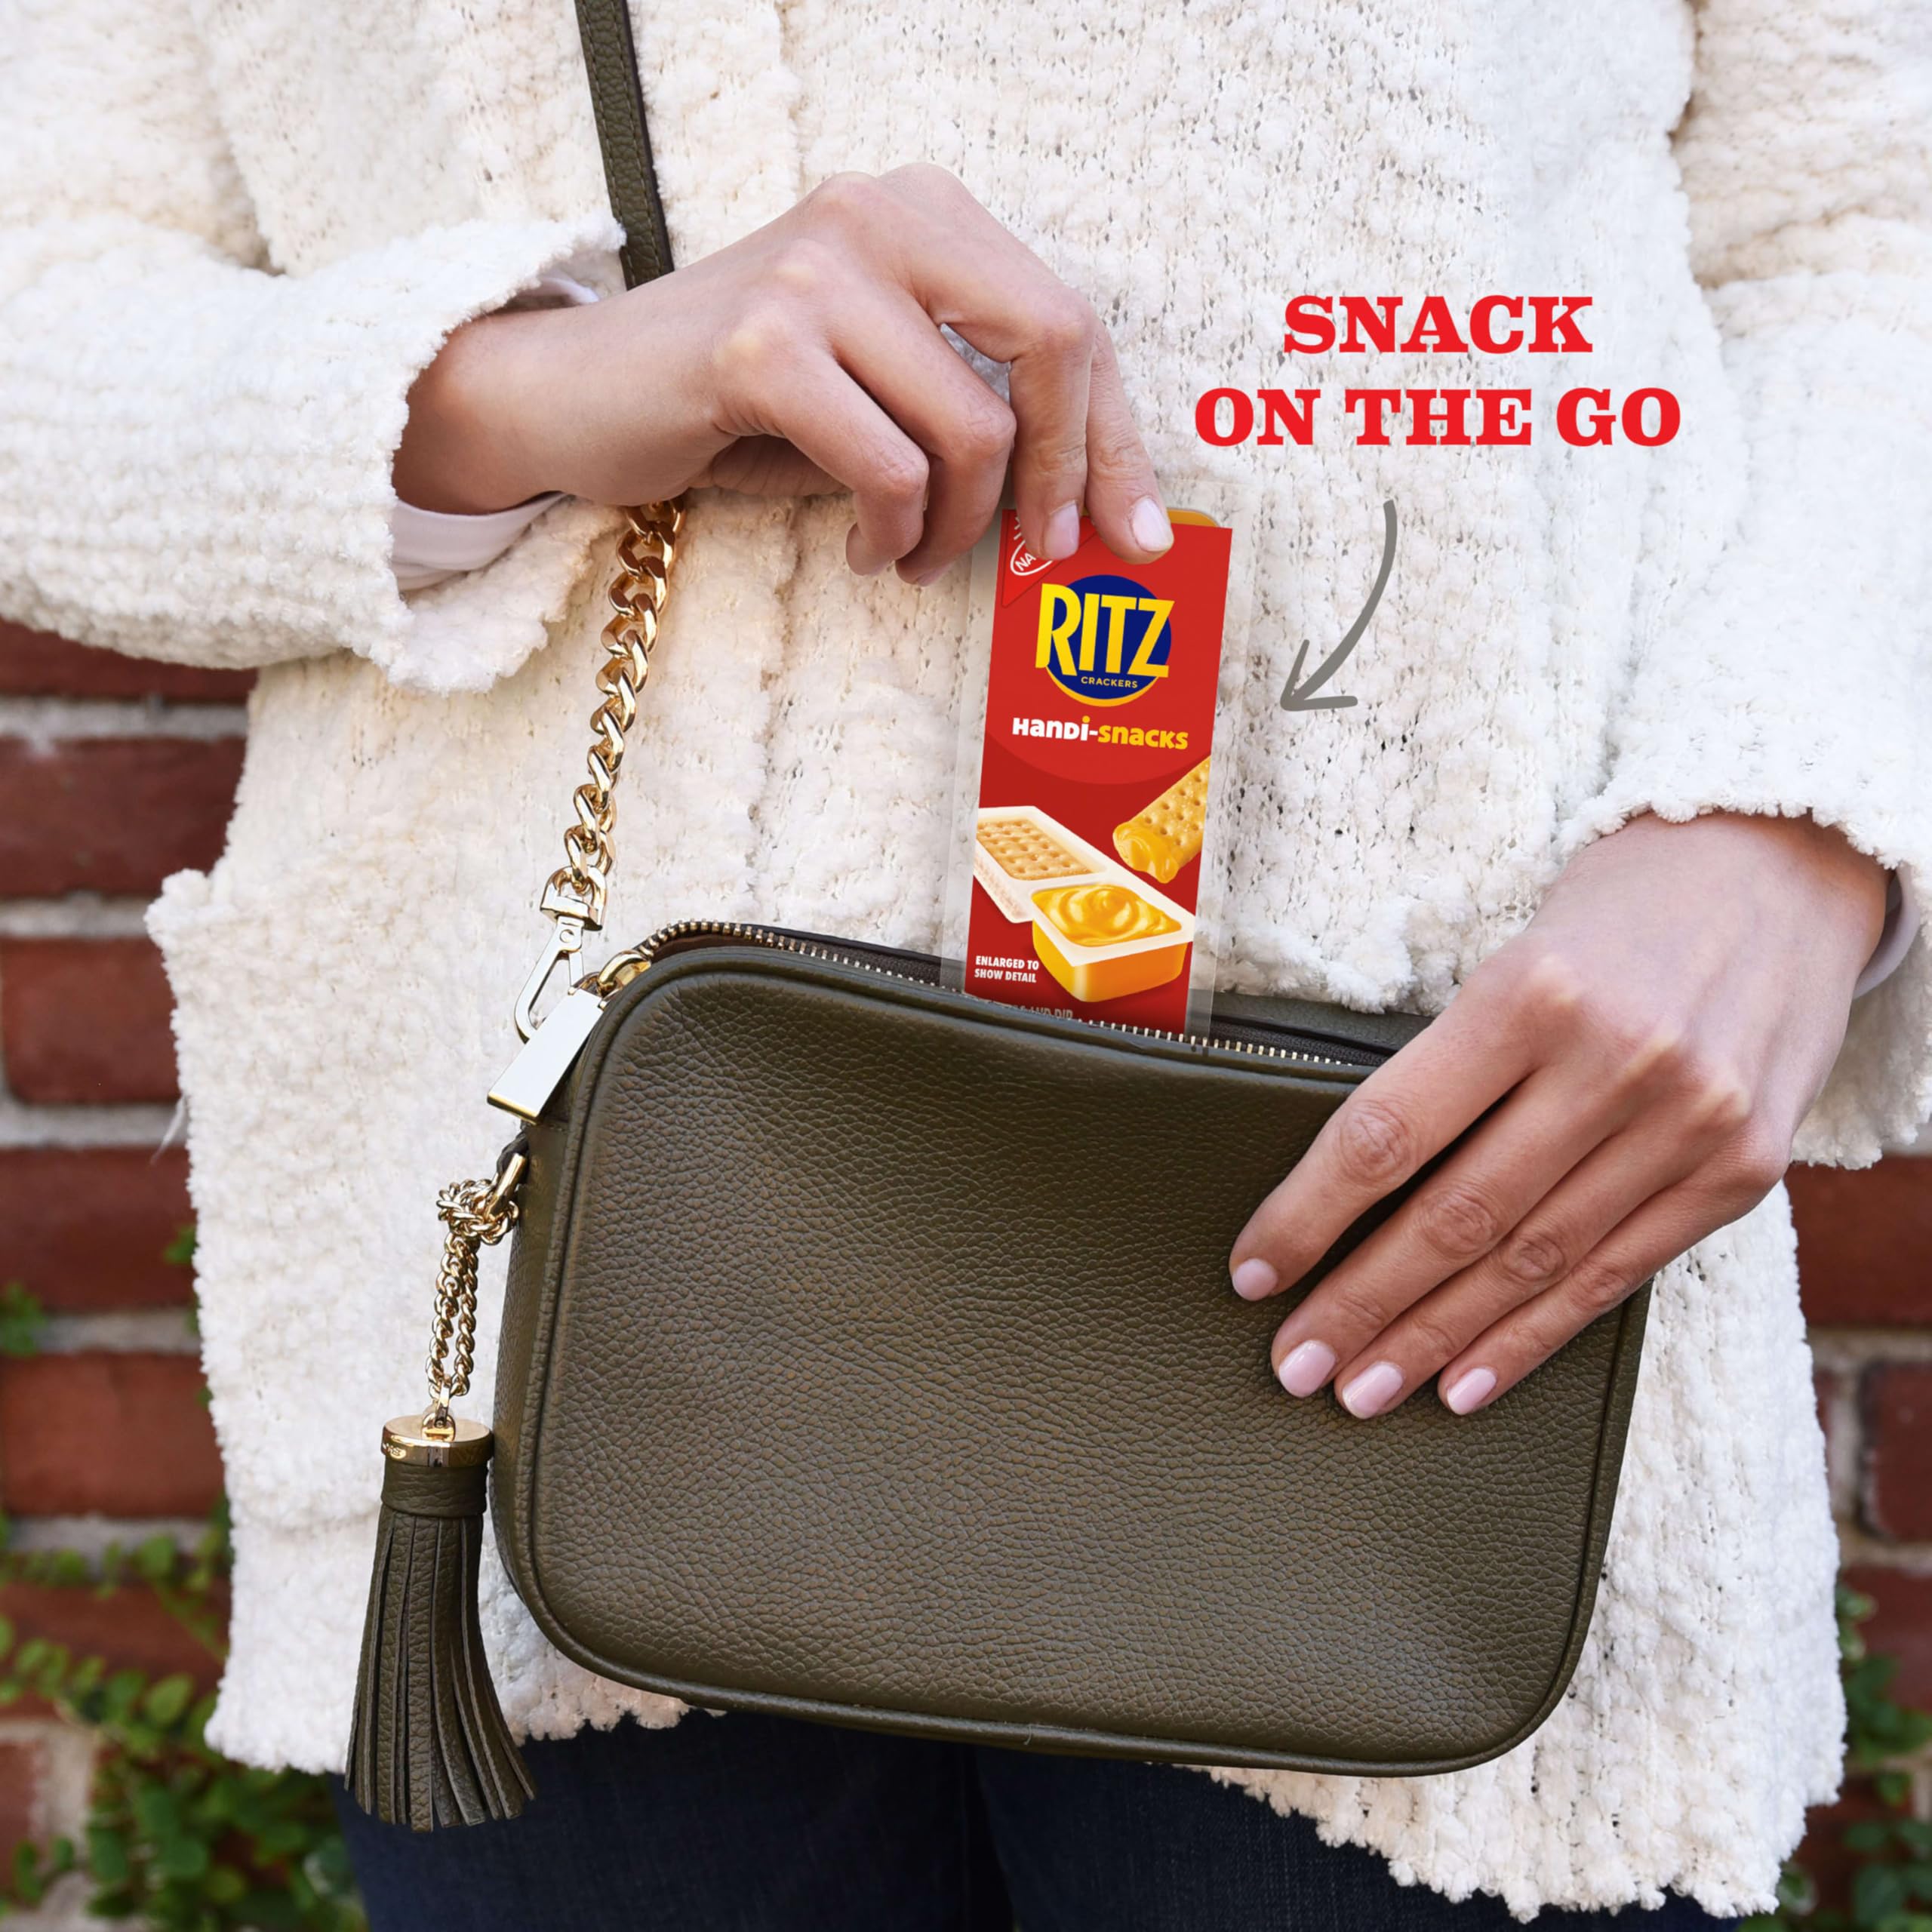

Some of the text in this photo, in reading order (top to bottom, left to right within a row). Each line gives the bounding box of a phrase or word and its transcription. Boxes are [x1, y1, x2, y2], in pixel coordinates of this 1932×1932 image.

[1035, 583, 1175, 678] RITZ
[1081, 676, 1138, 688] CRACKERS
[976, 955, 1039, 971] ENLARGED TO
[974, 968, 1037, 983] SHOW DETAIL
